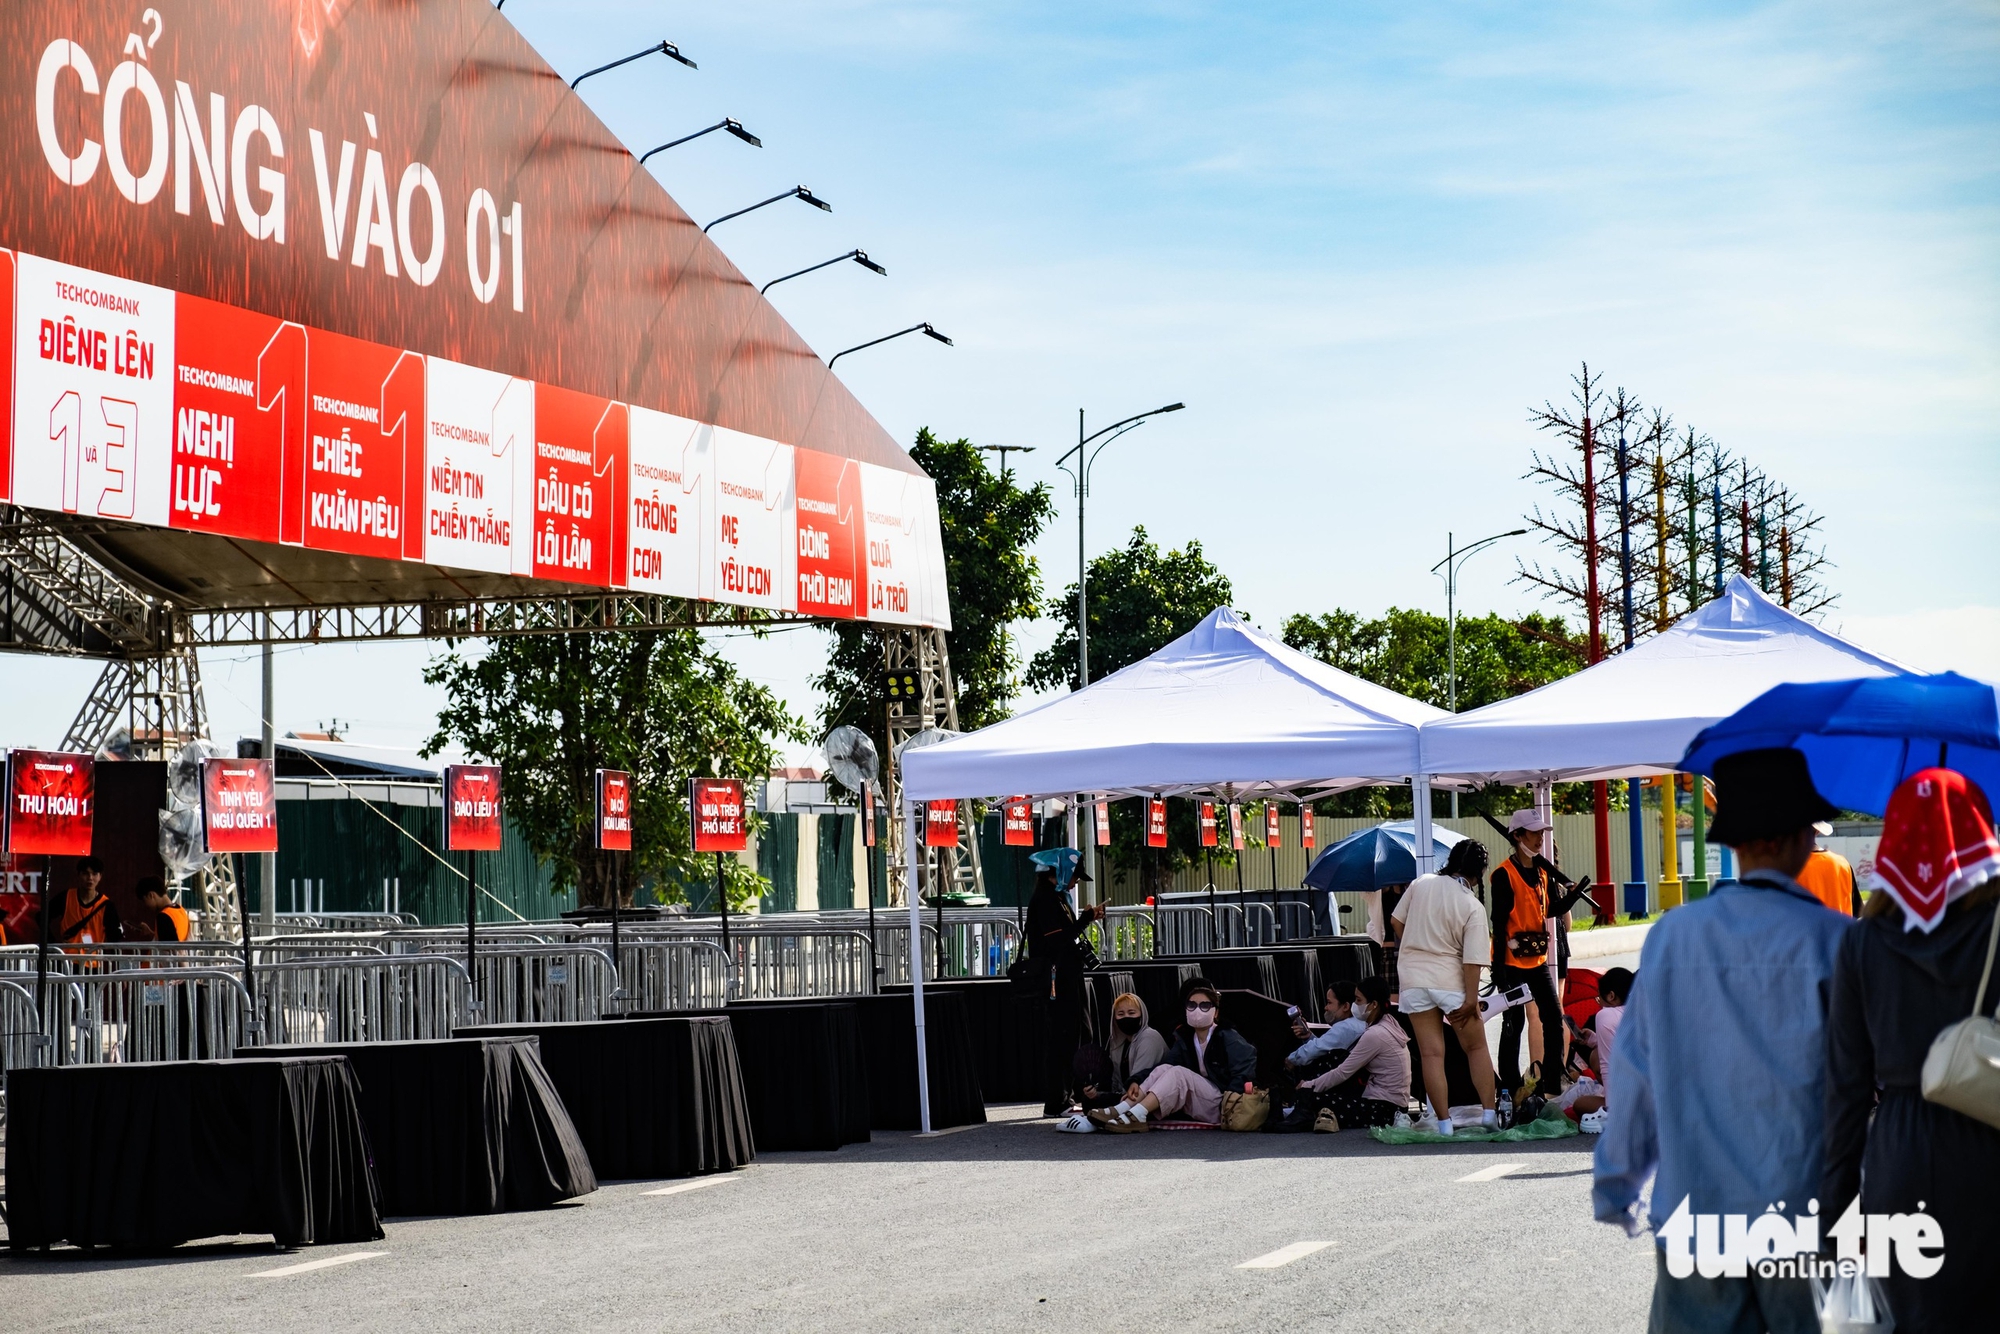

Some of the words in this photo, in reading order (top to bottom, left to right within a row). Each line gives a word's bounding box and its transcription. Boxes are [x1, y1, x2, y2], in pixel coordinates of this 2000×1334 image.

[36, 8, 285, 245] CỔNG
[308, 112, 445, 287] VÀO
[466, 188, 523, 312] 01
[56, 281, 139, 316] TECHCOMBANK
[39, 314, 107, 371] ĐIÊNG
[114, 329, 154, 380] LÊN
[178, 365, 254, 397] TECHCOMBANK
[313, 395, 379, 423] TECHCOMBANK
[177, 407, 234, 468] NGHỊ
[431, 421, 490, 446] TECHCOMBANK
[50, 391, 81, 513] 1
[313, 428, 362, 478] CHIẾC
[538, 442, 591, 466] TECHCOMBANK
[431, 457, 461, 496] NIỀM
[464, 472, 484, 499] TIN
[634, 463, 682, 485] TECHCOMBANK
[175, 464, 222, 520] LỰC
[538, 466, 569, 515] DẪU
[572, 481, 592, 519] CÓ
[721, 482, 764, 502] TECHCOMBANK
[798, 497, 837, 516] TECHCOMBANK
[311, 488, 358, 532] KHĂN
[361, 496, 399, 539] PIÊU
[431, 502, 467, 540] CHIẾN
[469, 508, 510, 546] THẮNG
[634, 489, 677, 534] TRỐNG
[867, 511, 902, 528] TECHCOMBANK
[537, 518, 559, 565] LỖI
[563, 523, 591, 570] LẦM
[722, 514, 739, 549] MẸ
[799, 524, 829, 560] DÒNG
[633, 547, 661, 580] CƠM
[870, 539, 892, 569] QUÁ
[721, 556, 744, 593] YÊU
[747, 566, 771, 596] CON
[800, 570, 826, 604] THỜI
[828, 577, 852, 606] GIAN
[871, 579, 883, 610] LÀ
[886, 581, 908, 613] TRÔI
[18, 794, 44, 814] THU
[47, 792, 78, 816] HOÀI
[81, 798, 87, 816] 1
[218, 787, 241, 807] TÌNH
[243, 788, 263, 807] YÊU
[454, 797, 472, 817] ĐÀO
[493, 802, 498, 817] 1
[720, 802, 739, 817] TRÊN
[212, 808, 234, 829] NGỦ
[236, 809, 264, 829] QUÊN
[265, 813, 271, 828] 1
[615, 817, 627, 831] LANG
[720, 818, 735, 834] HUẾ
[736, 822, 740, 834] 1
